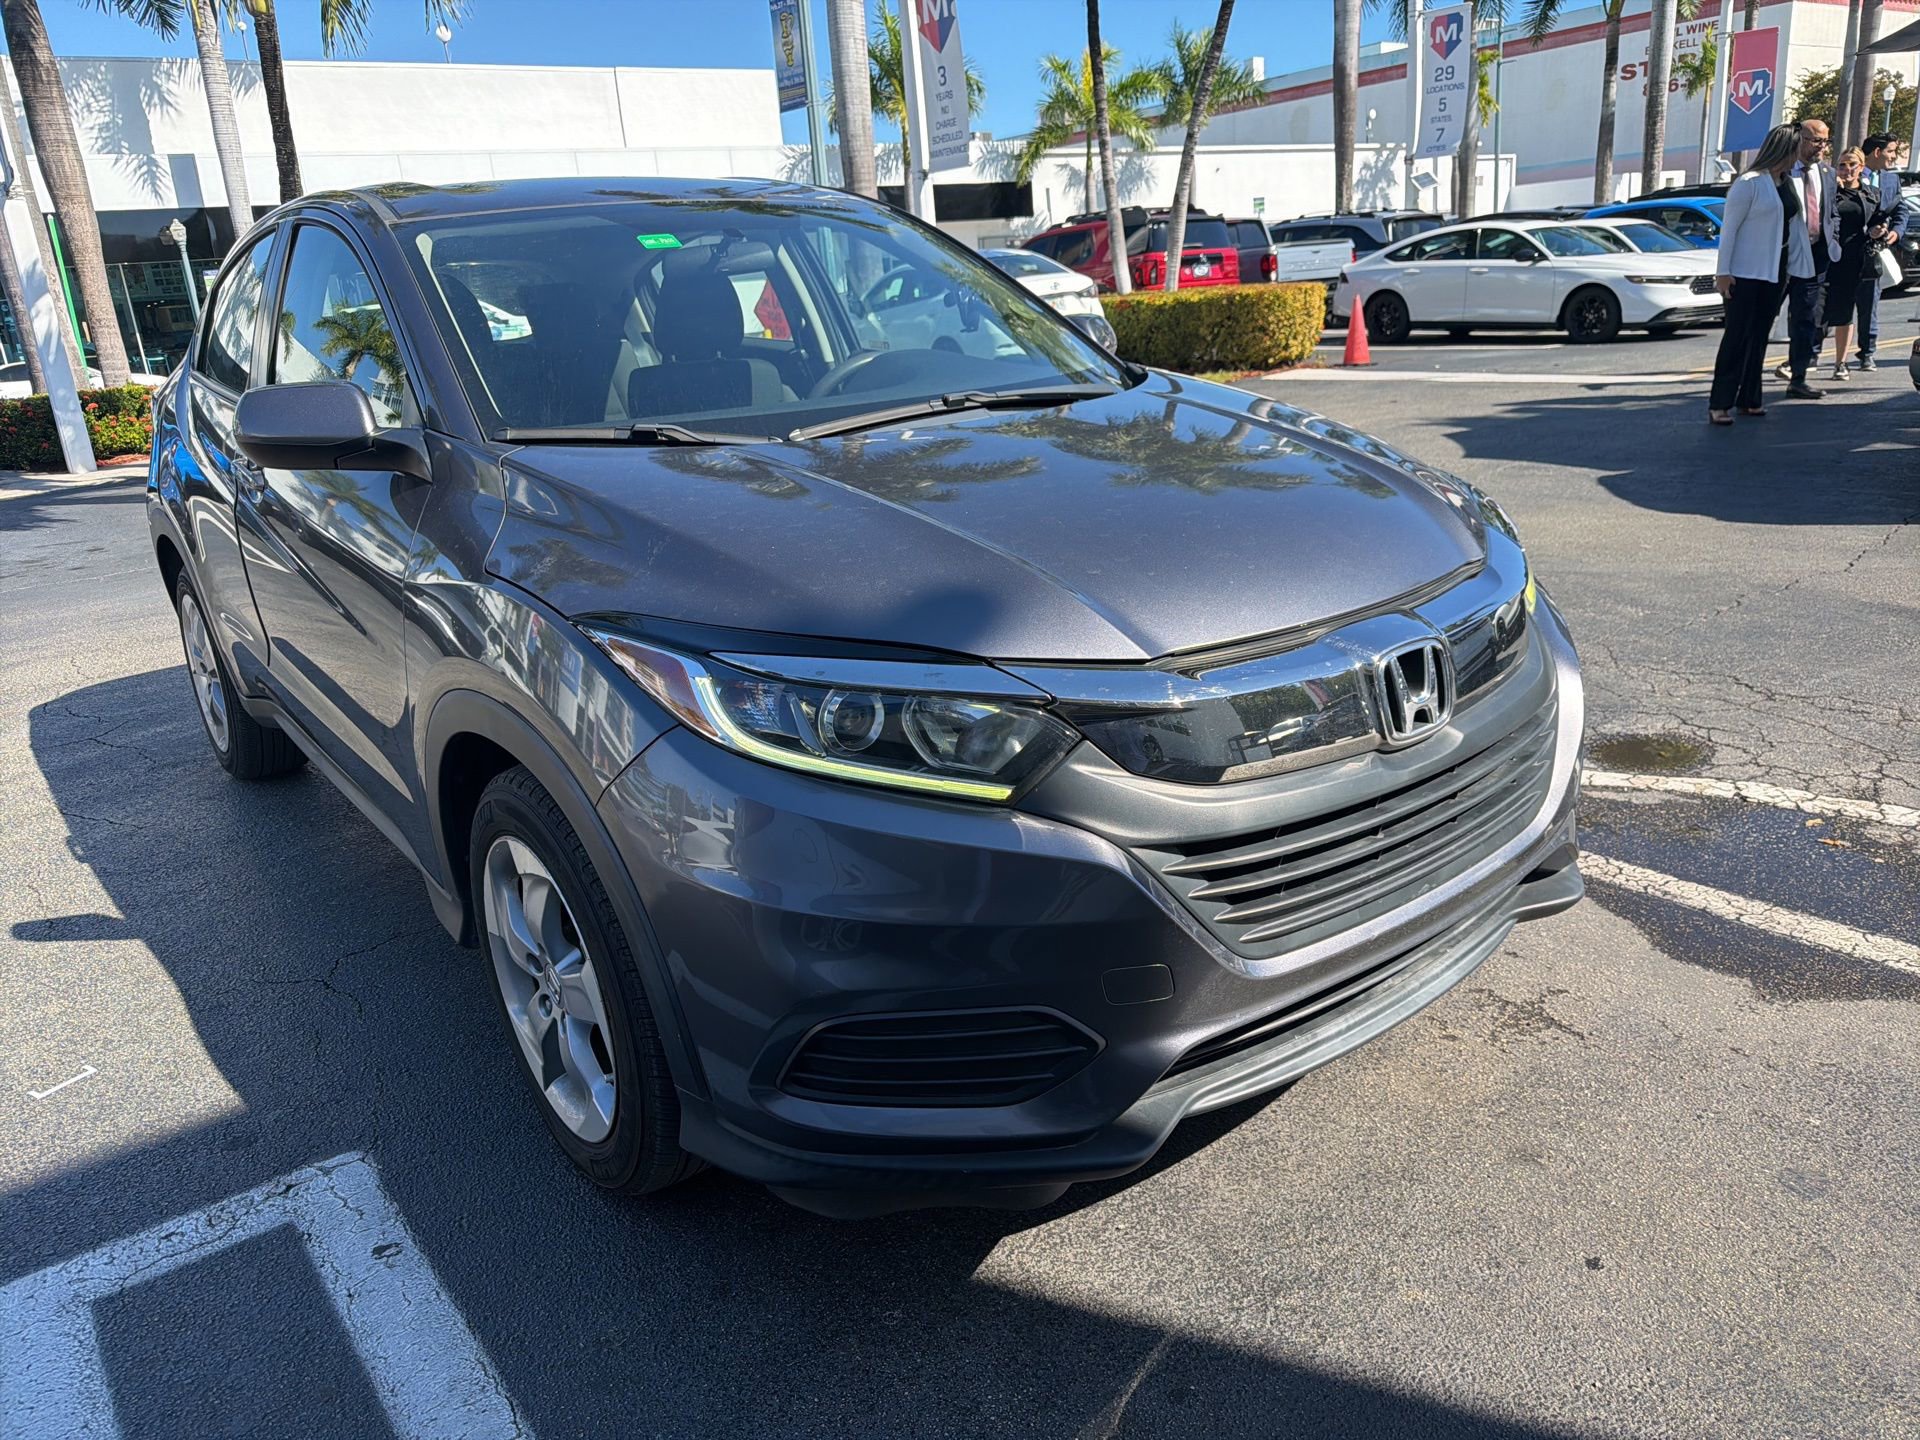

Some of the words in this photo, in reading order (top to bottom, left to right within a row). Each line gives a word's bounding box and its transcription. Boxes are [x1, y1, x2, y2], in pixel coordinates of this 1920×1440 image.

[1435, 23, 1458, 44] M
[1686, 19, 1719, 35] WINE
[937, 66, 947, 86] 3
[1434, 65, 1455, 82] 29
[935, 90, 953, 102] YEARS
[1426, 82, 1466, 95] LOCATIONS
[1738, 79, 1764, 98] M
[941, 105, 950, 114] NO
[1438, 97, 1447, 112] 5
[935, 117, 957, 130] CHARGE
[1430, 114, 1453, 124] STATES
[932, 130, 963, 145] SCHEDULED
[1435, 127, 1445, 143] 7
[931, 143, 967, 158] MAINTENANCE
